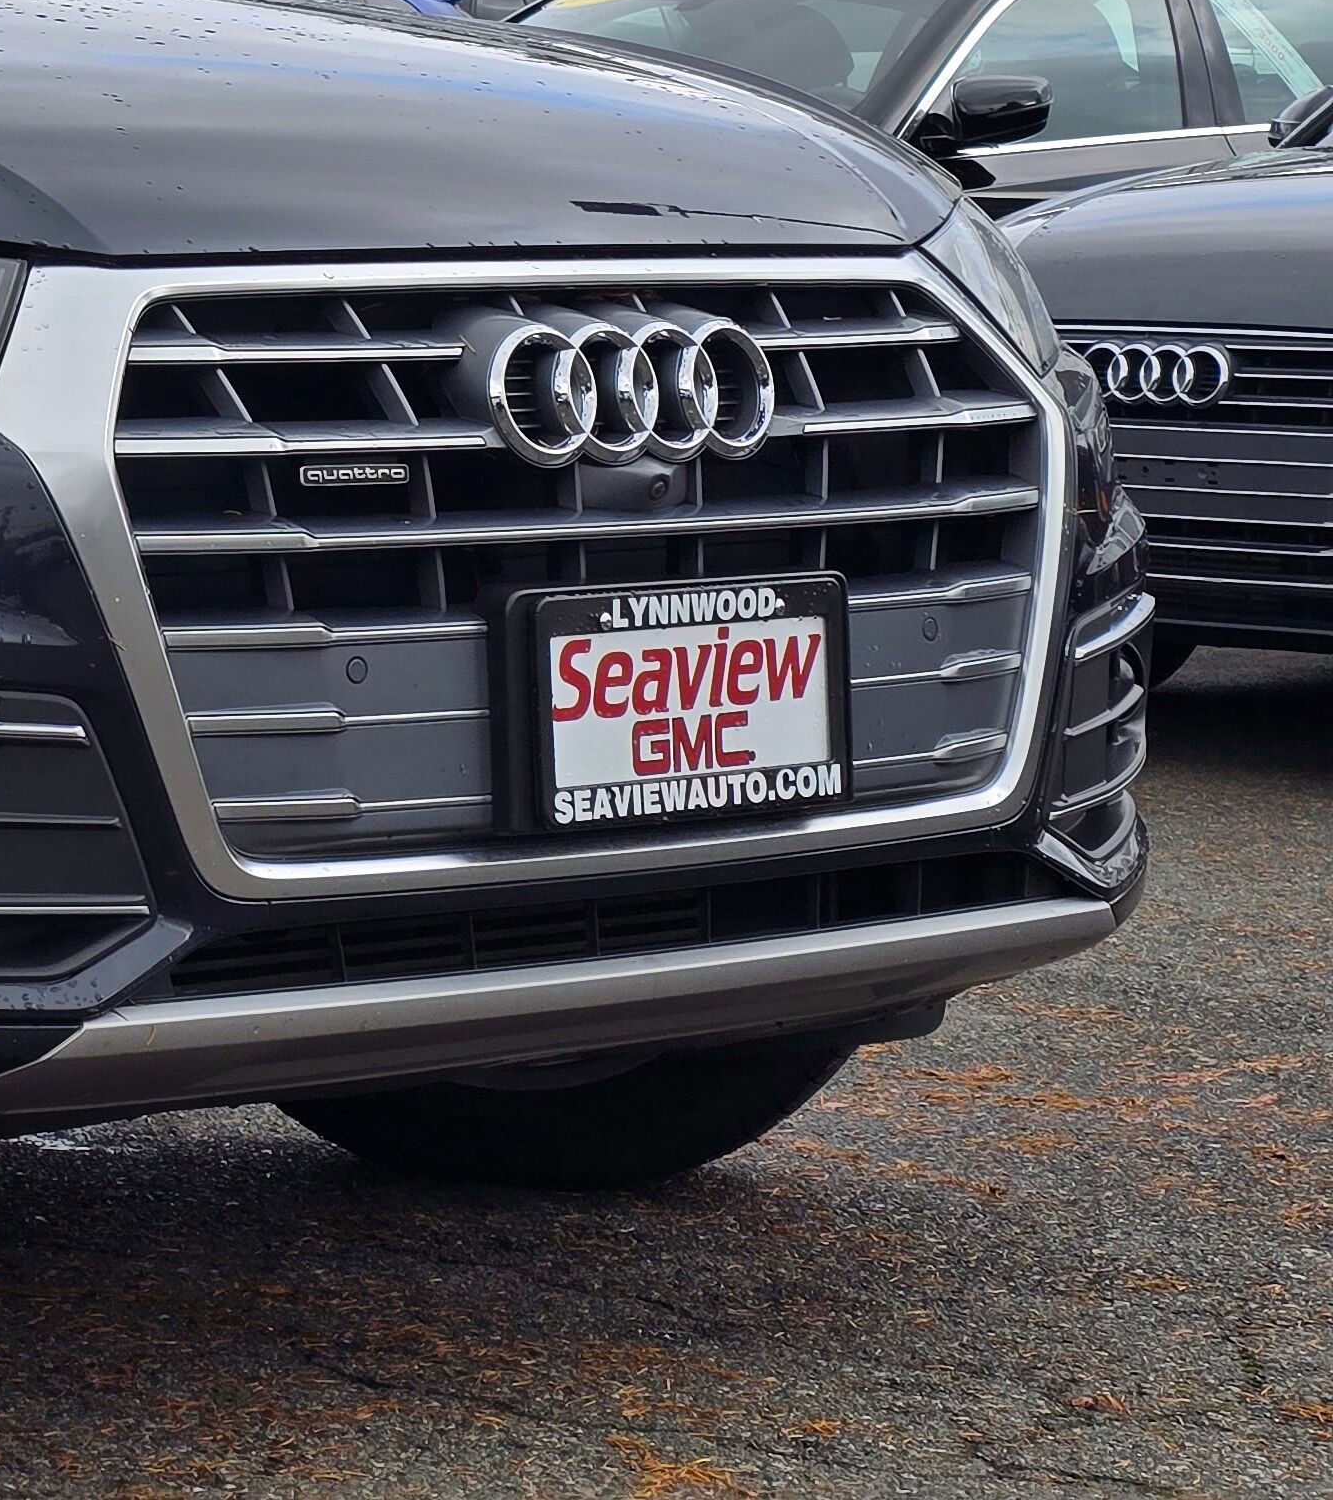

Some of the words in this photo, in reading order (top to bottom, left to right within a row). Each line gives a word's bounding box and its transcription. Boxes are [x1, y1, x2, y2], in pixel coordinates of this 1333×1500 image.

[307, 467, 406, 483] quattro
[612, 587, 777, 629] LYNNWOOD
[552, 626, 822, 723] Seaview
[632, 710, 757, 777] GMC
[554, 763, 842, 825] SEAVIEWAUTO.COM
